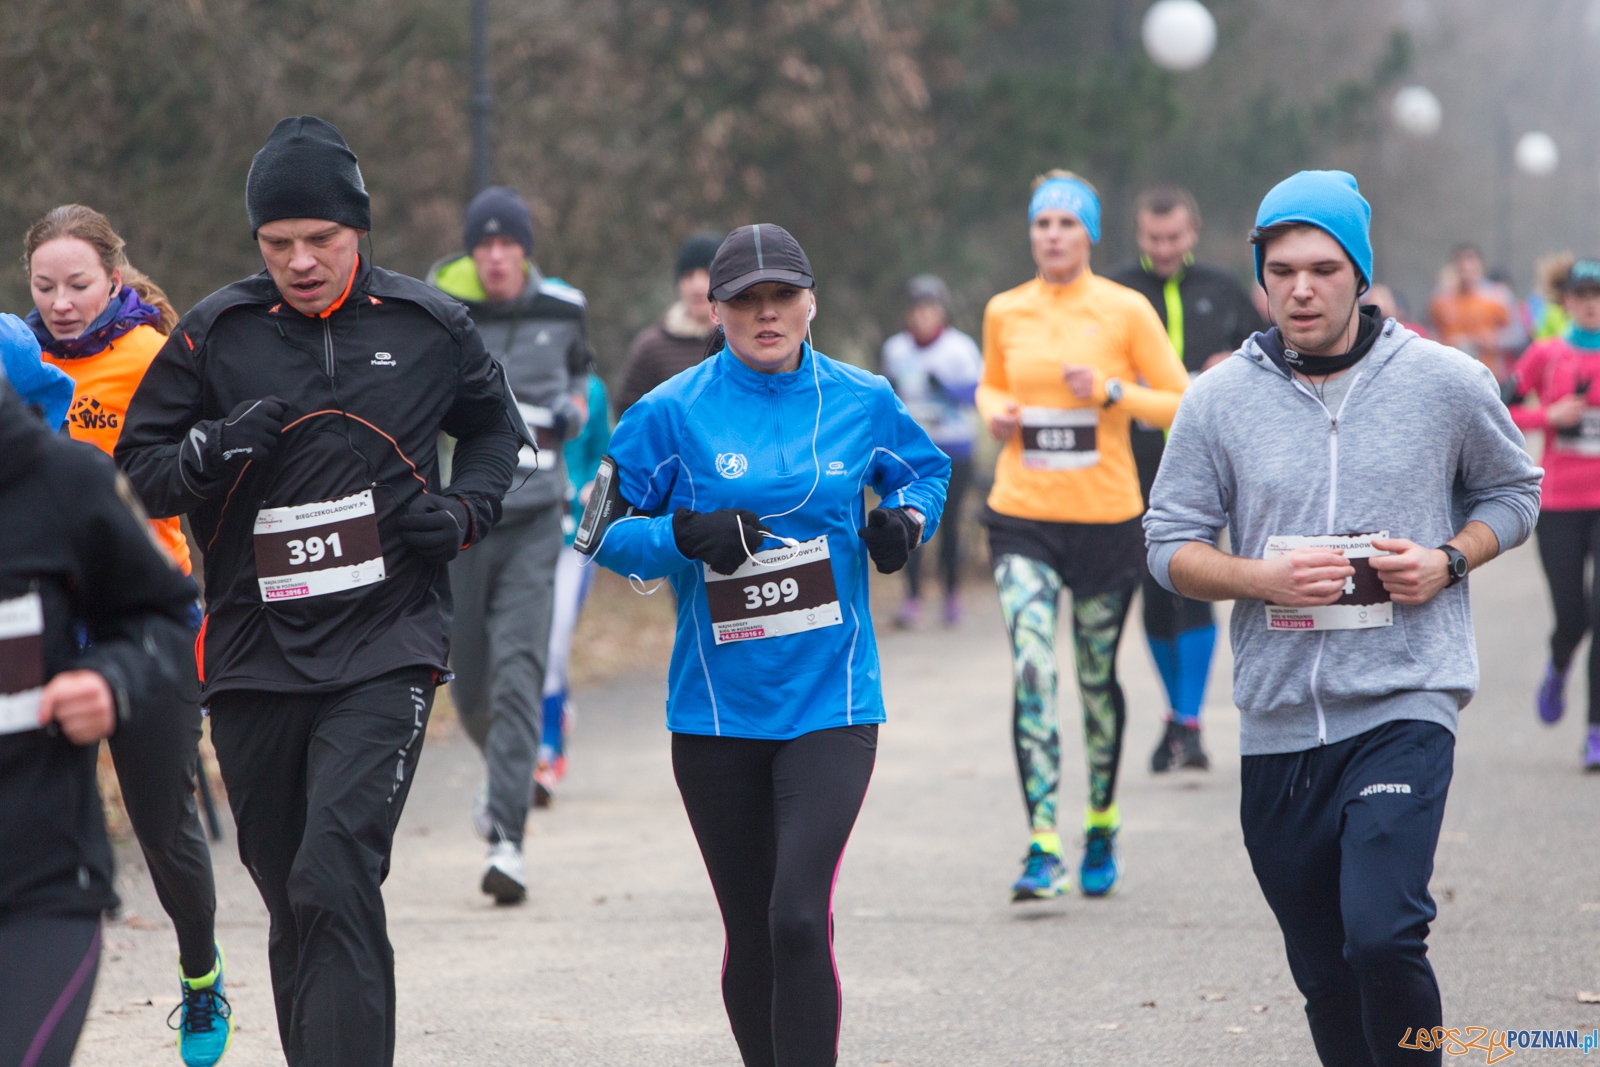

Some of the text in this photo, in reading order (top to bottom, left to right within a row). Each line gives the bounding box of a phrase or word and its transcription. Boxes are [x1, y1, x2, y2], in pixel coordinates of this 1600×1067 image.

[82, 413, 118, 429] WSG
[295, 501, 368, 521] BIEGCZEKOLADOWY.PL
[286, 532, 343, 566] 391
[742, 576, 800, 611] 399
[721, 631, 758, 641] 14.02.2016
